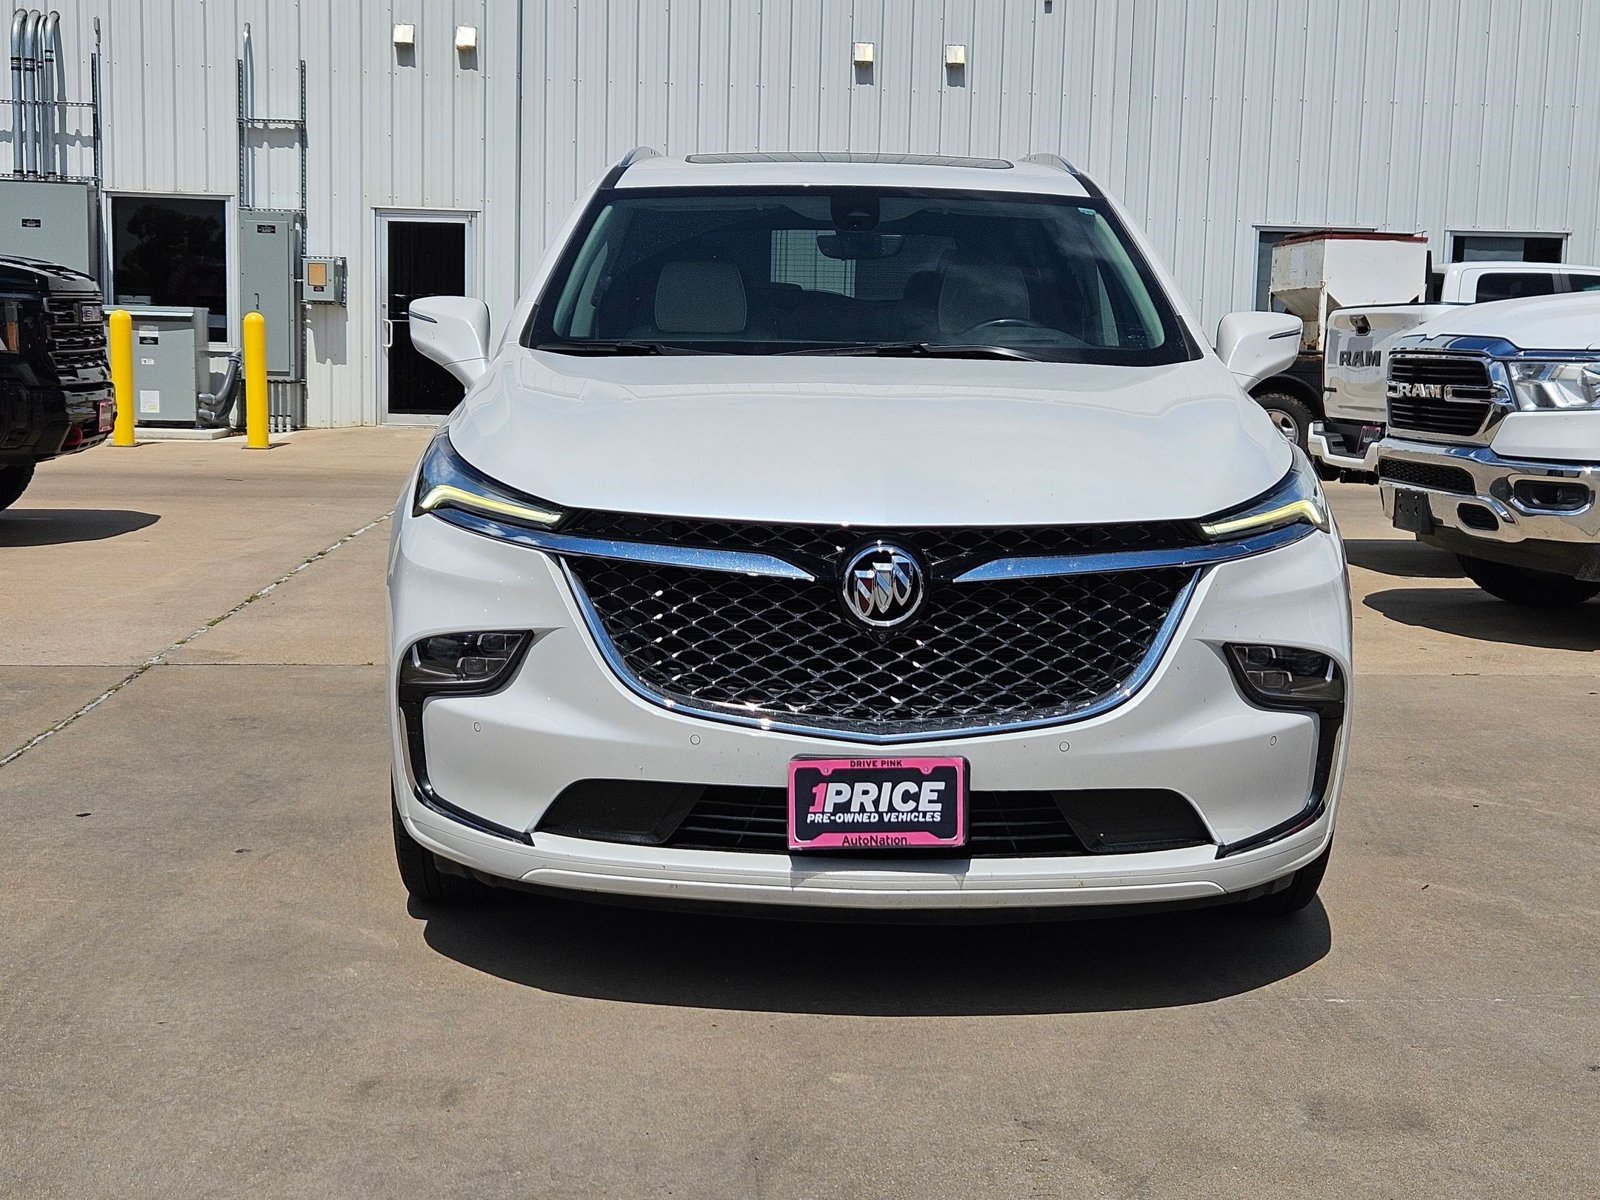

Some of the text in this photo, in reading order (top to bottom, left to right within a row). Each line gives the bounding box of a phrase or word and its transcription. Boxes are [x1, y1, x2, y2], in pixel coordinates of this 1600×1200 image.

[1339, 350, 1381, 366] RAM
[1400, 382, 1442, 398] RAM
[806, 812, 942, 823] PRE-OWNED VEHICLES
[842, 834, 907, 847] AutoNation
